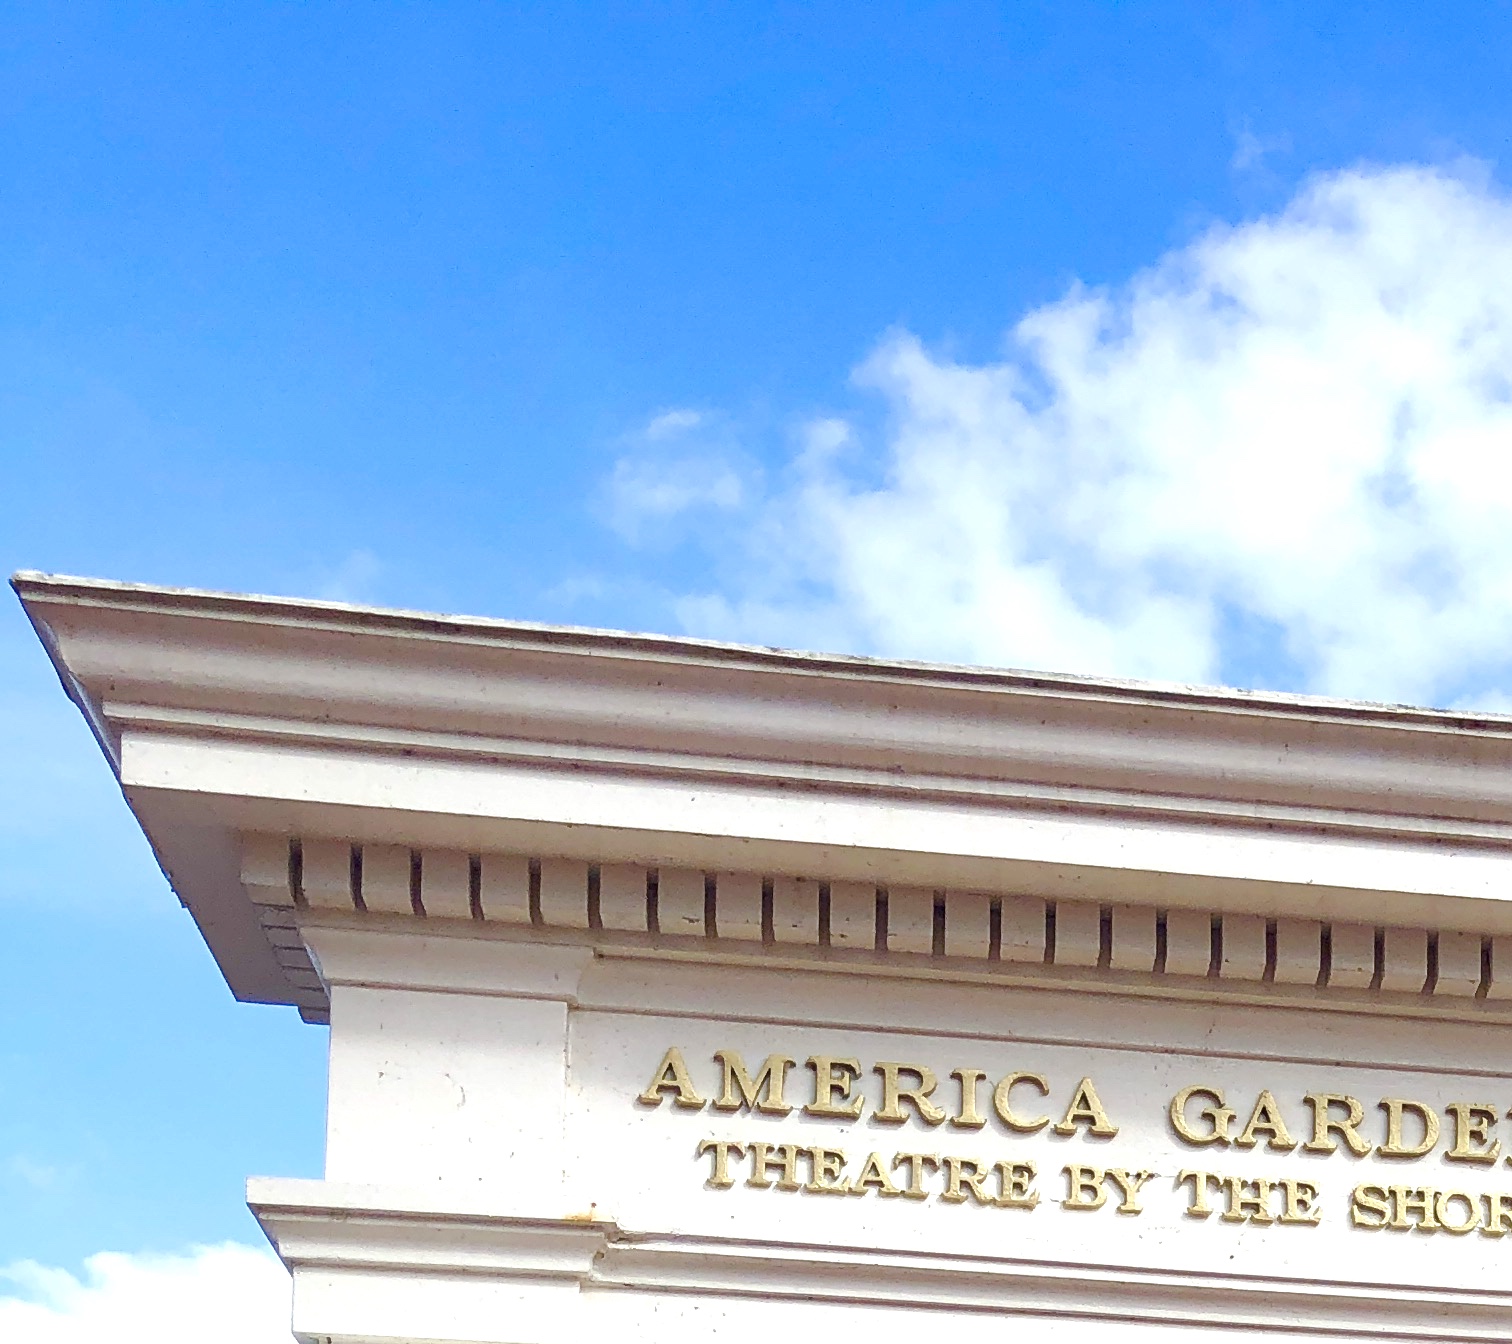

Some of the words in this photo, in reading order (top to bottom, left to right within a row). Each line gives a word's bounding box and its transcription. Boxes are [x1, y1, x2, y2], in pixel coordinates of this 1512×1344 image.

[636, 1045, 1119, 1137] AMERICA
[697, 1138, 1041, 1210] THEATRE
[1060, 1163, 1156, 1215] BY
[1177, 1168, 1323, 1226] THE
